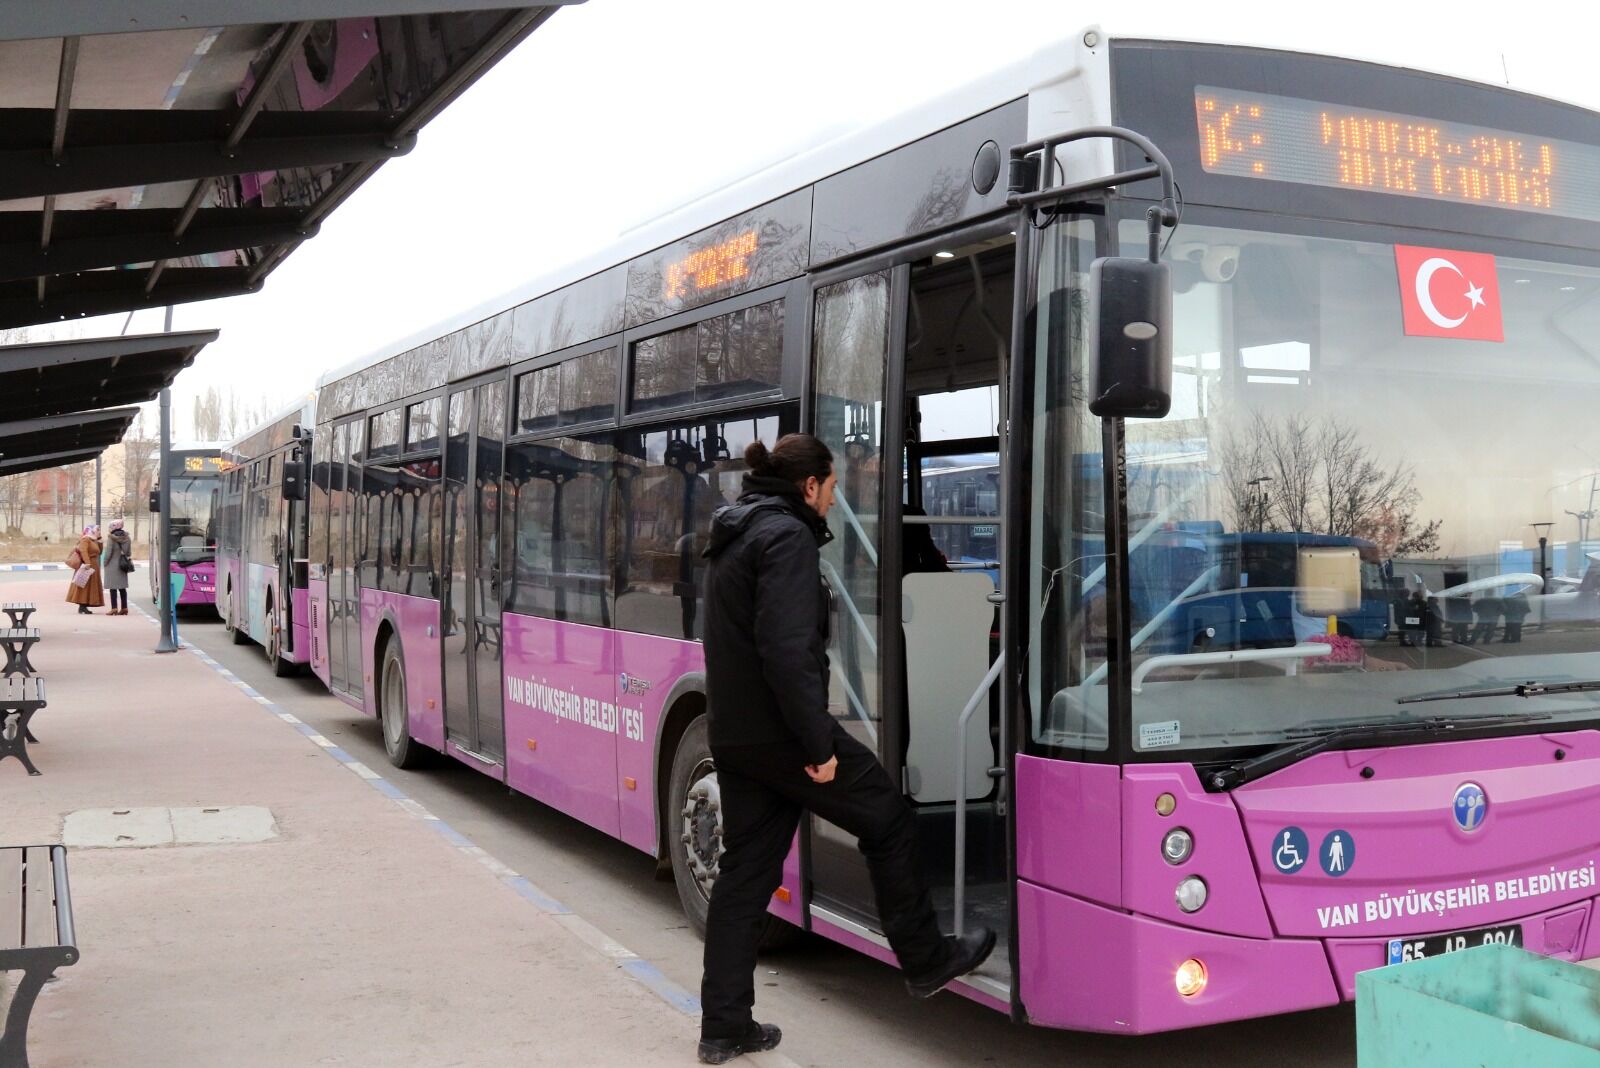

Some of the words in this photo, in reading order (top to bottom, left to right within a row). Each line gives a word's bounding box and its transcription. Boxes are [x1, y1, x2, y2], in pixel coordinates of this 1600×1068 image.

[507, 675, 524, 704] VAN
[525, 674, 581, 724] BÜYÜKŞEHİR
[1317, 903, 1359, 928] VAN
[1365, 879, 1490, 917] BÜYÜKŞEHİR
[1494, 860, 1595, 902] BELEDİYESİ
[1401, 942, 1426, 963] 65
